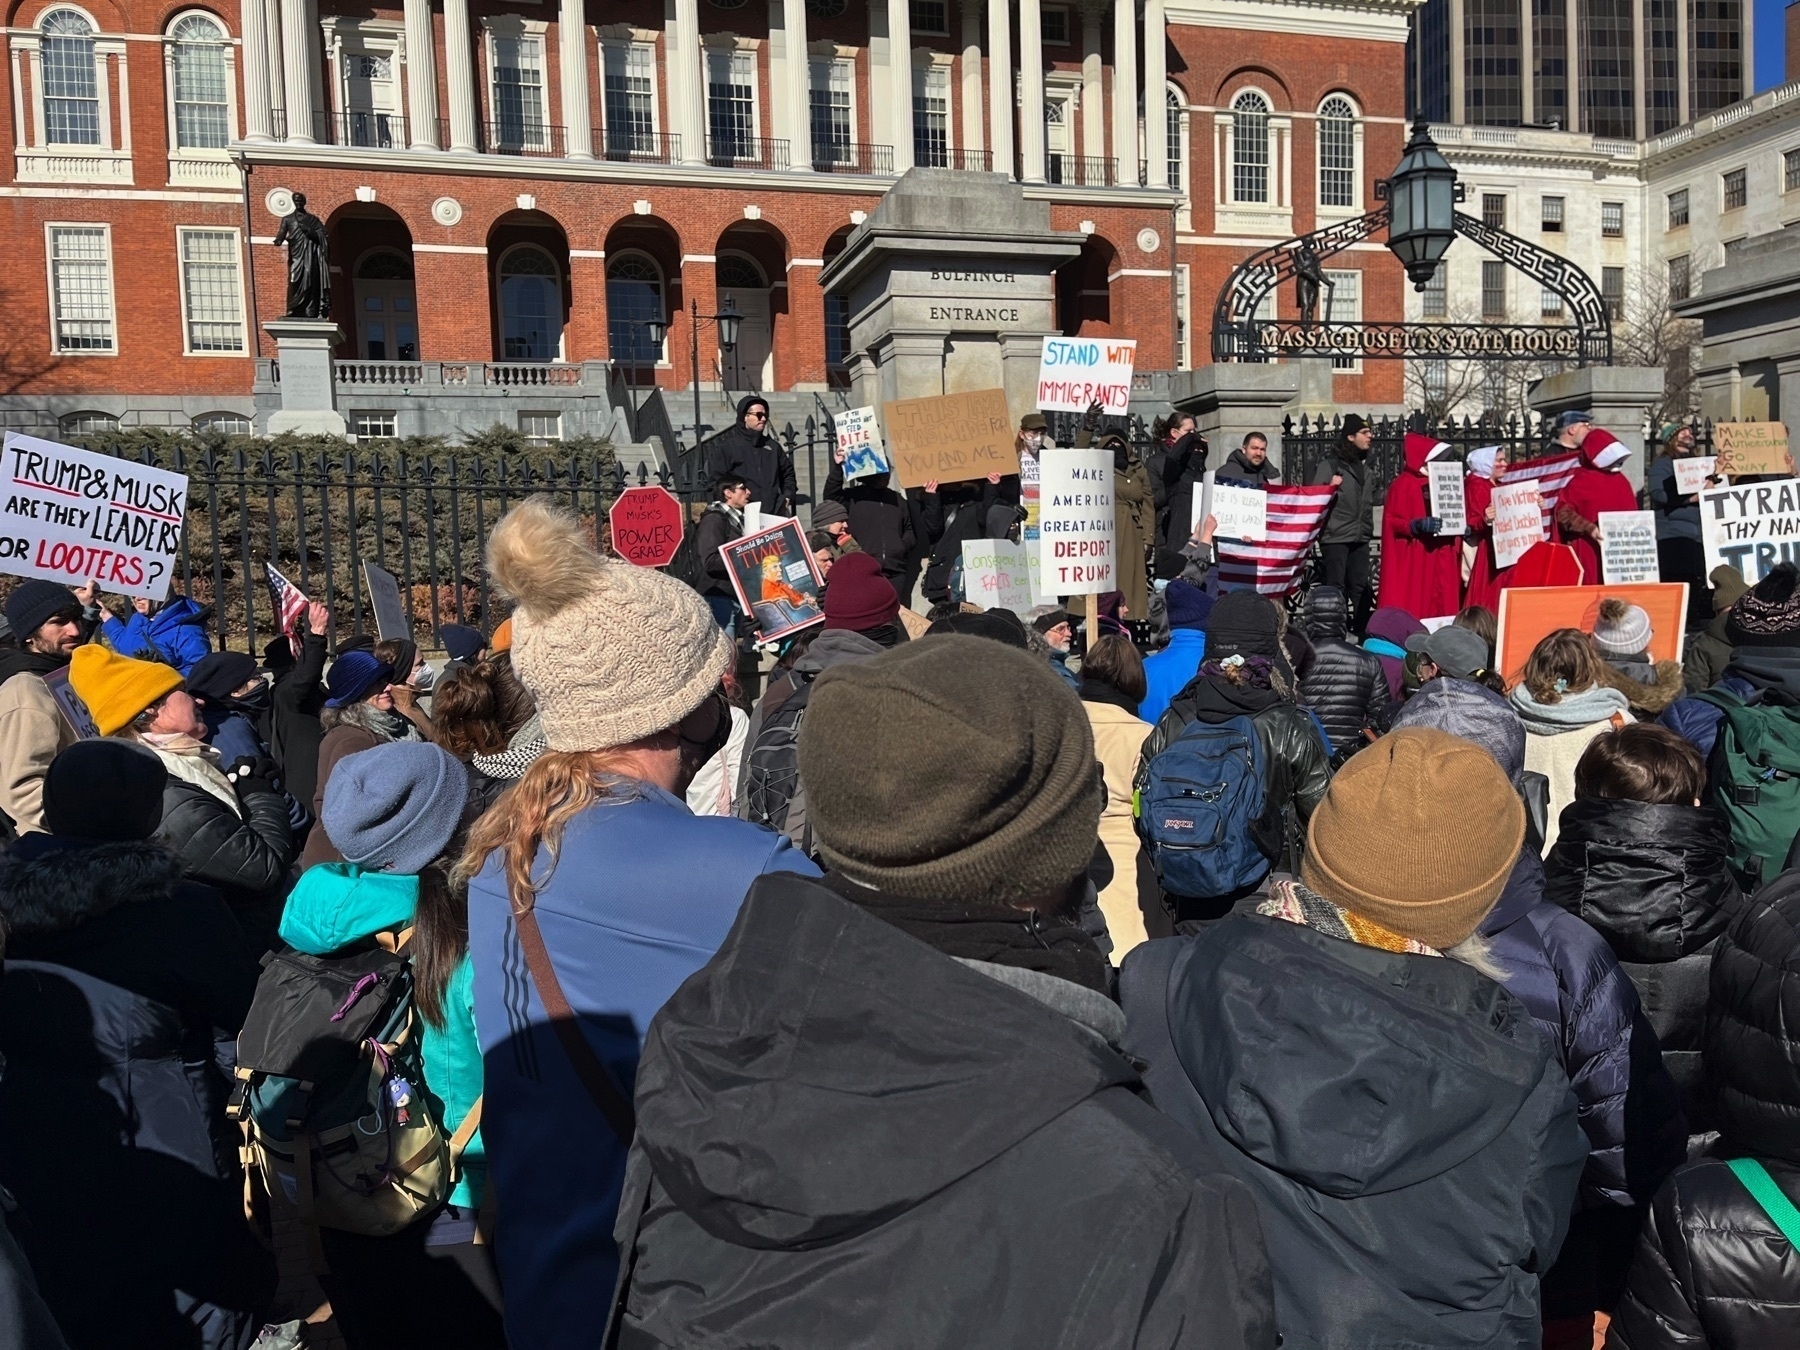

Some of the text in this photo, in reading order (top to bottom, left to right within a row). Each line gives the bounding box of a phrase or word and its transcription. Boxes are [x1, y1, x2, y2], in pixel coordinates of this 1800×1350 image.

[930, 268, 1015, 282] BULFINCH
[930, 307, 1018, 321] ENTRANCE
[1261, 330, 1576, 350] MASSACHUSETTS STATE HOUSE
[1044, 342, 1099, 366] STAND
[1040, 381, 1128, 407] IMMIGRANTS
[896, 397, 959, 427] THIS
[846, 424, 862, 433] FEED
[938, 420, 988, 444] MADE
[990, 417, 1008, 436] FOR
[1719, 427, 1766, 438] MAKE
[840, 431, 870, 446] BITE
[904, 454, 934, 476] YOU
[938, 450, 967, 468] AND
[1723, 450, 1745, 461] GO
[1072, 468, 1104, 481] MAKE
[1722, 462, 1767, 472] AWAY
[111, 474, 182, 518] MUSK
[623, 493, 659, 504] TRUMP
[1053, 494, 1109, 506] AMERICA
[627, 510, 662, 520] MUSK'S
[5, 496, 181, 556] ARE THEY LEADERS
[1044, 520, 1113, 532] GREAT AGAIN
[1722, 520, 1760, 540] THY
[618, 525, 674, 547] POWER
[736, 531, 784, 554] Should Be Doing
[0, 537, 30, 560] OR
[629, 545, 665, 559] GRAB
[737, 537, 790, 568] TIME
[1054, 540, 1110, 558] DEPORT
[981, 573, 1010, 591] FACTS
[1058, 564, 1110, 582] TRUMP
